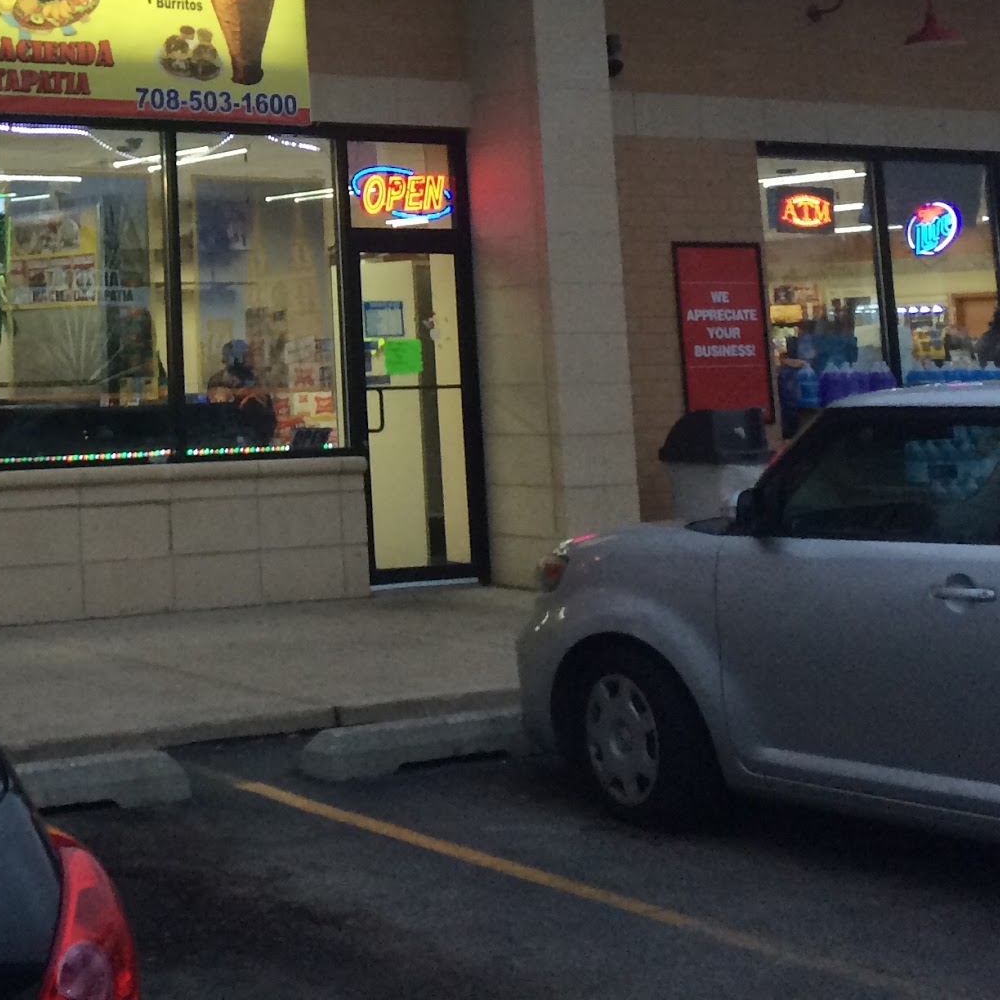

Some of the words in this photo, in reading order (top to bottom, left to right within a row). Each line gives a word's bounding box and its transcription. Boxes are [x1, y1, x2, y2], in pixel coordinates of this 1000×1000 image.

[135, 87, 297, 117] 708-503-1600
[361, 174, 446, 214] OPEN
[780, 199, 832, 224] ATM
[711, 291, 730, 304] WE
[686, 308, 758, 322] APPRECIATE
[707, 327, 741, 340] YOUR
[694, 344, 756, 358] BUSINESS!
